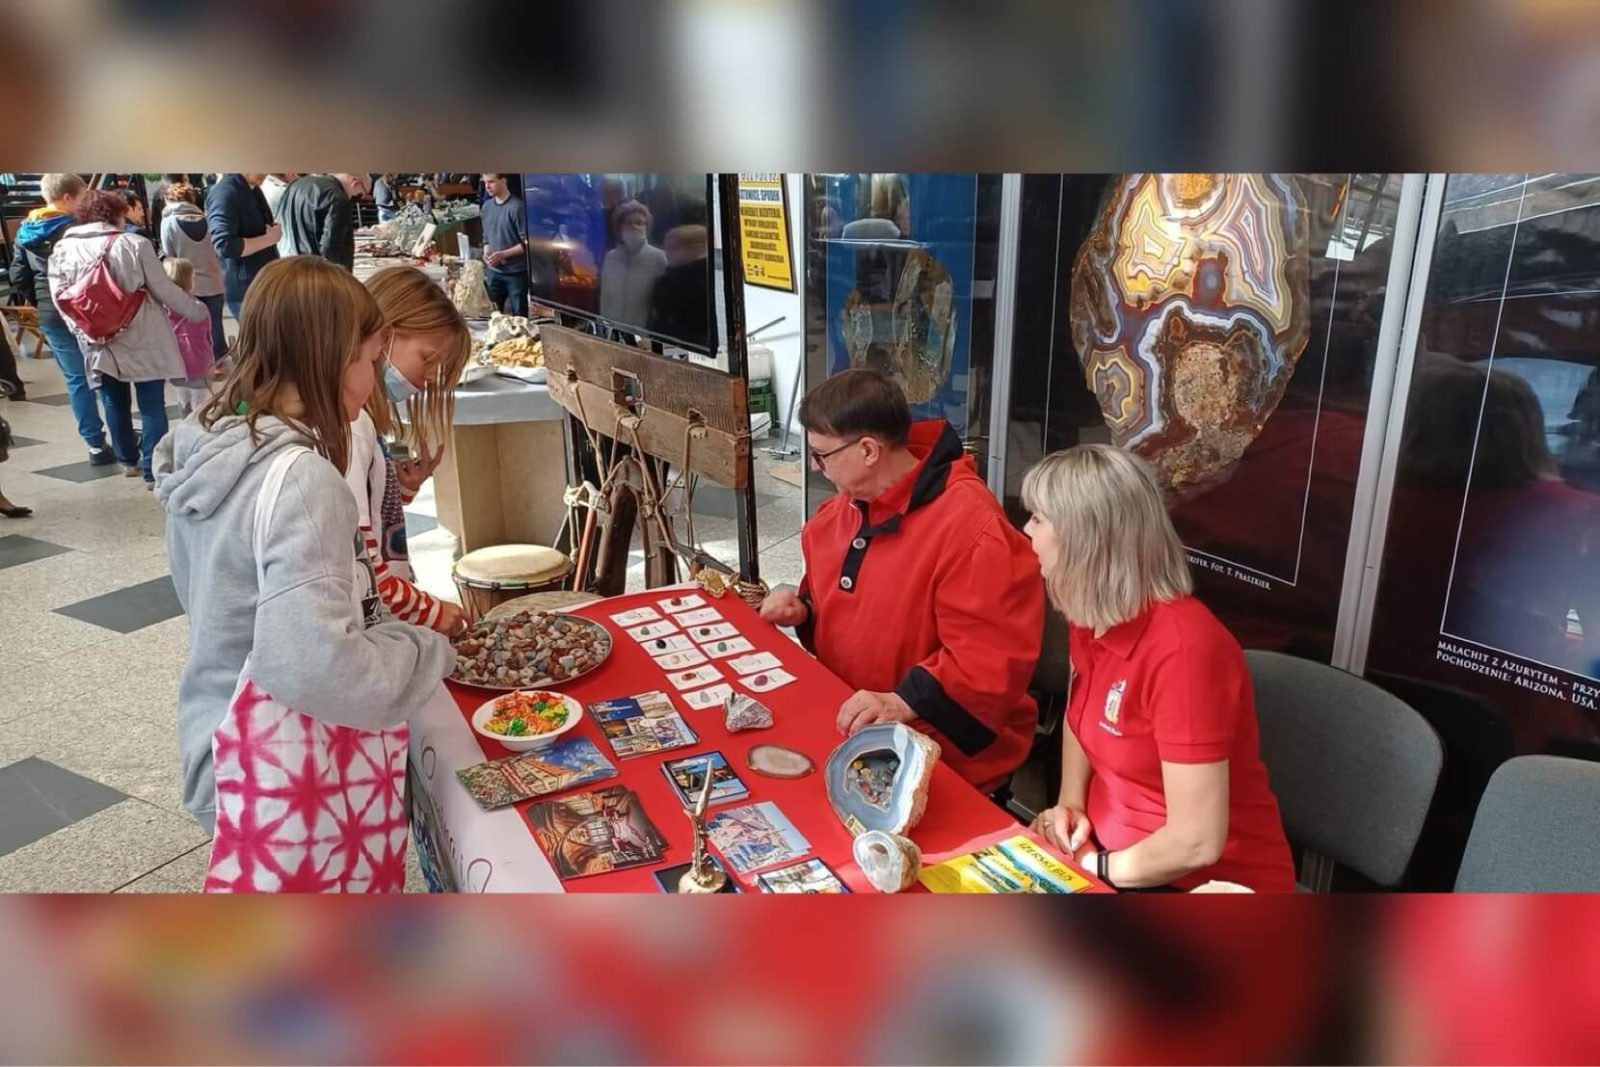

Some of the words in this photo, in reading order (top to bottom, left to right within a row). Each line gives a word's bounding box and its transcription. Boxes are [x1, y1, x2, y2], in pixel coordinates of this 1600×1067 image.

[1436, 650, 1511, 681] POCHODZENIE:
[1572, 693, 1598, 710] USA.
[1438, 641, 1489, 662] MALACHIT
[1492, 656, 1499, 666] Z
[1501, 660, 1558, 685] AZURYTEM
